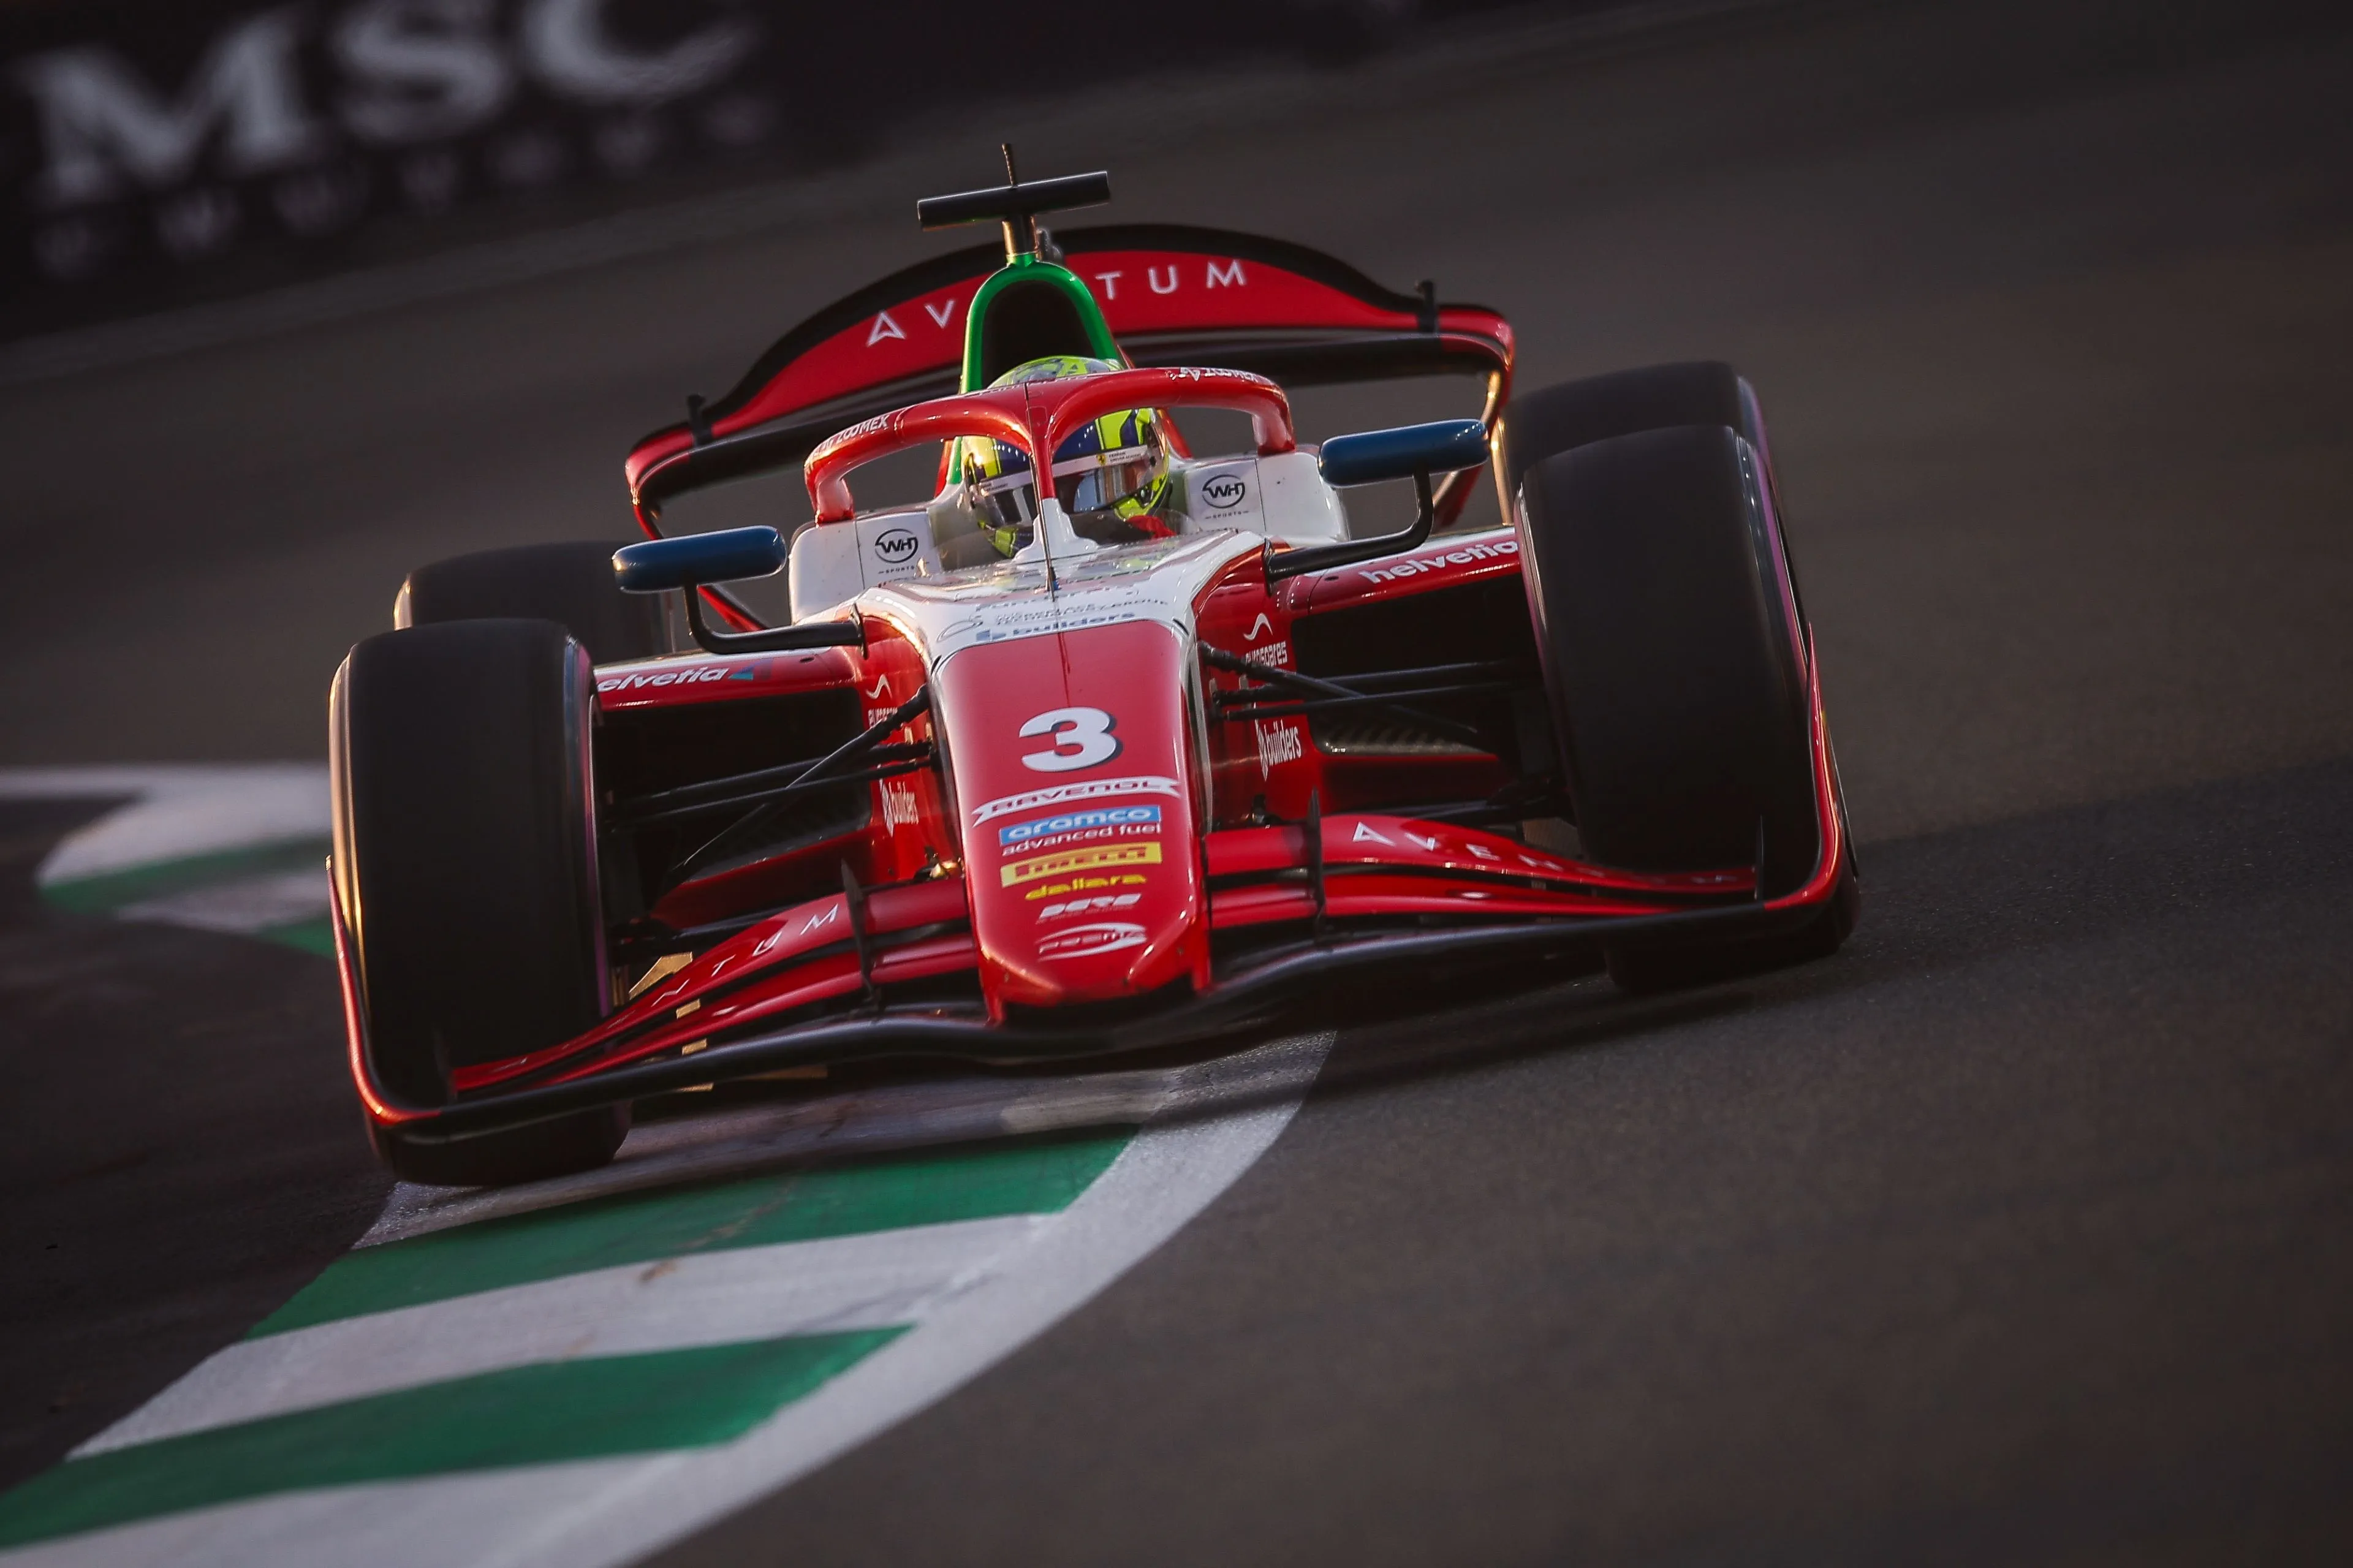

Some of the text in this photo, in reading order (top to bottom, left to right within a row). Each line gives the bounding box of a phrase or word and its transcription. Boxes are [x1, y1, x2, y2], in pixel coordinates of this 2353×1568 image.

[25, 0, 748, 199] MSC
[865, 259, 1248, 348] AVTUM
[836, 414, 890, 444] ZOOMEX
[1358, 540, 1519, 584] helvetia
[596, 665, 730, 693] elvetia
[1019, 706, 1123, 773] 3
[1263, 718, 1302, 767] builders
[991, 779, 1162, 812] RAVENOL
[1001, 822, 1162, 857] advanced fuel
[1008, 808, 1152, 841] aramco
[1025, 874, 1146, 901] dallara
